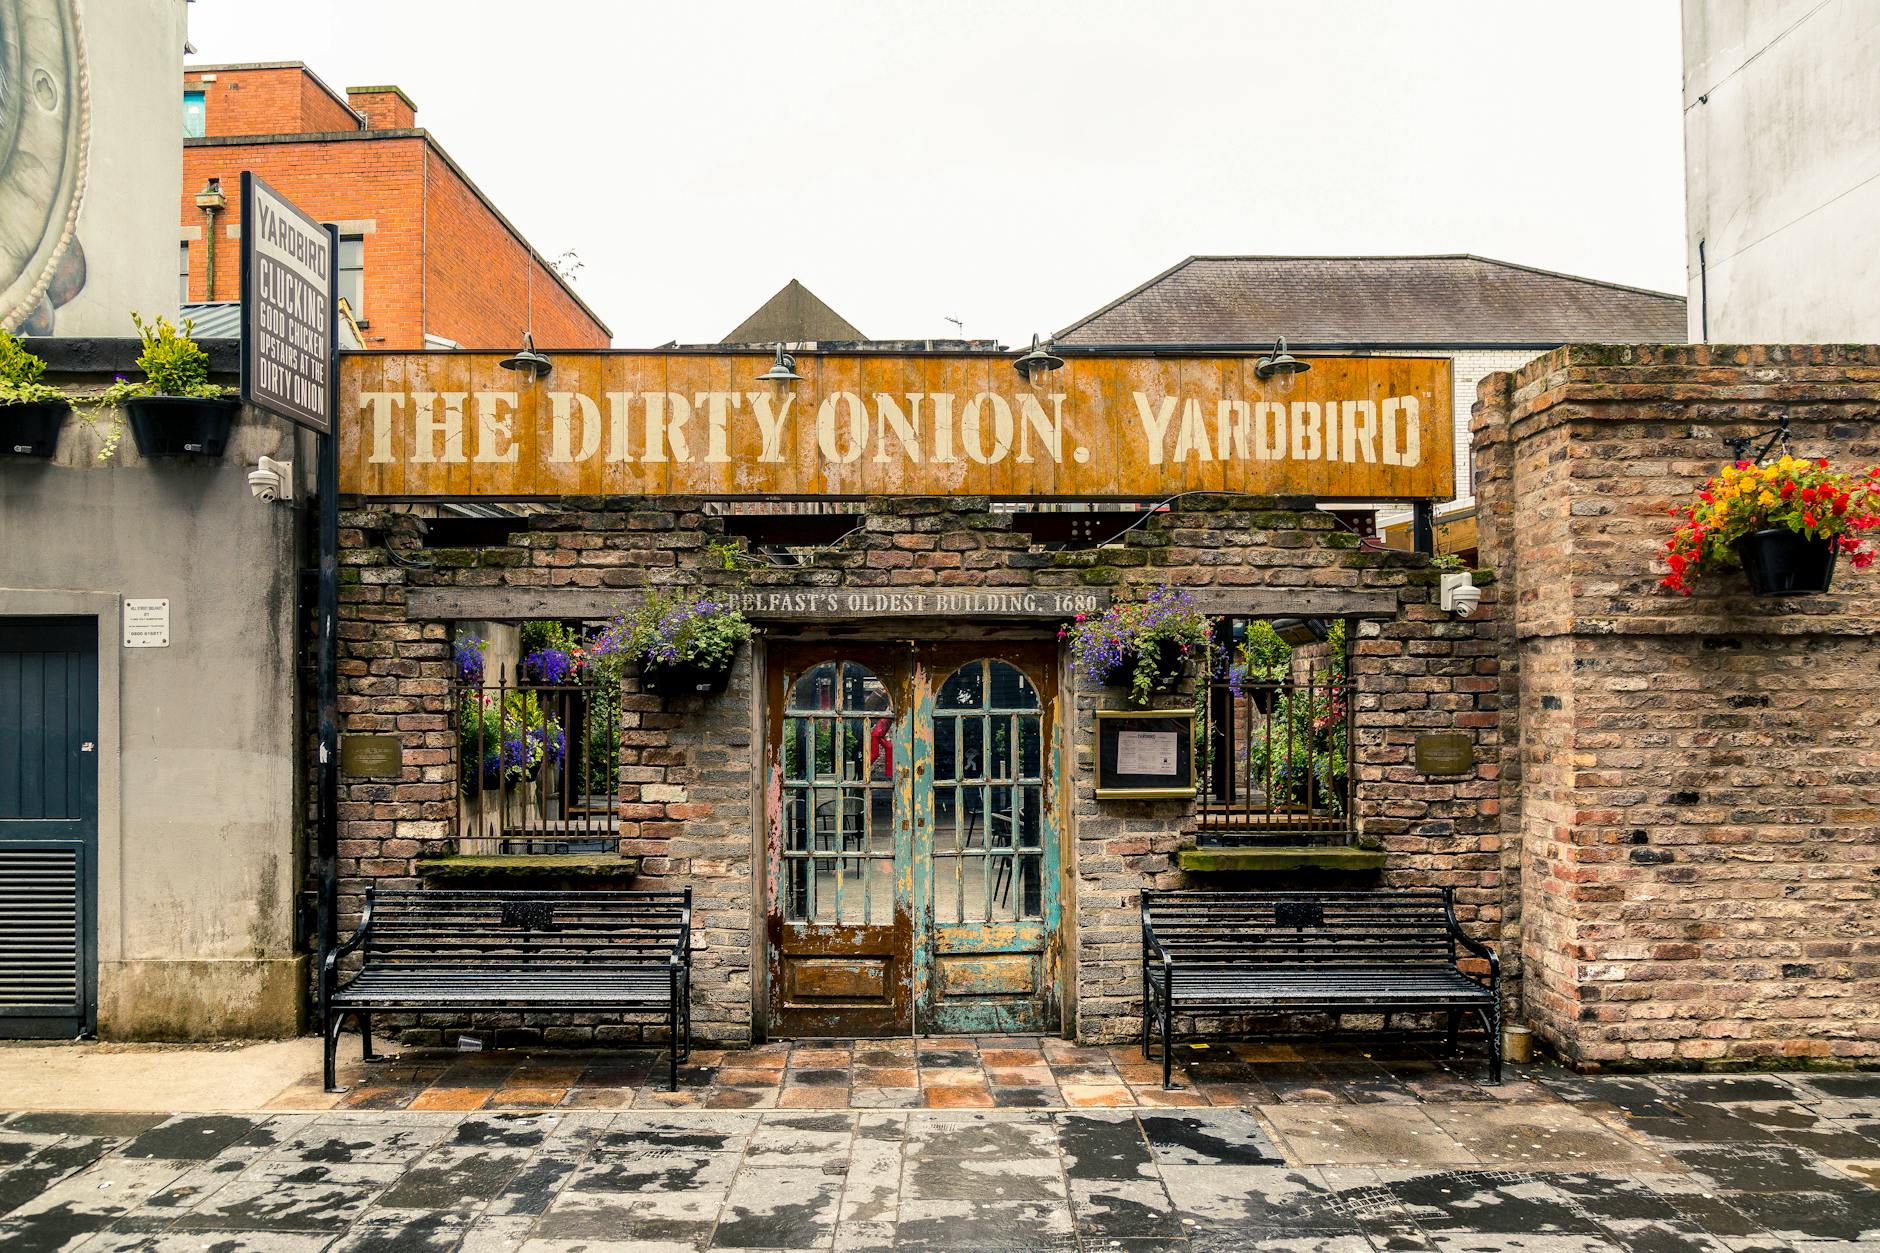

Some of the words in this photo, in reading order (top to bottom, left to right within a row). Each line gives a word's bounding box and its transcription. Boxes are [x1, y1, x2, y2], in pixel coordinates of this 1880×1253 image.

[257, 196, 327, 281] YARDBIRD
[260, 258, 324, 332] CLUCKING
[260, 301, 285, 335] GOOD
[288, 318, 324, 361] CHICKEN
[260, 331, 298, 371] UPSTAIRS
[299, 352, 310, 375] AT
[311, 357, 324, 385] THE
[260, 356, 292, 400] DIRTY
[294, 374, 324, 416] ONION
[360, 391, 519, 464] THE
[547, 391, 797, 464] DIRTY
[816, 391, 1090, 466] ONION.
[1132, 391, 1420, 468] YARDBIRD
[728, 593, 838, 612] BELFAST'S
[848, 594, 927, 612] OLDEST
[936, 595, 1044, 612] BUILDING.
[1053, 595, 1097, 612] 1680
